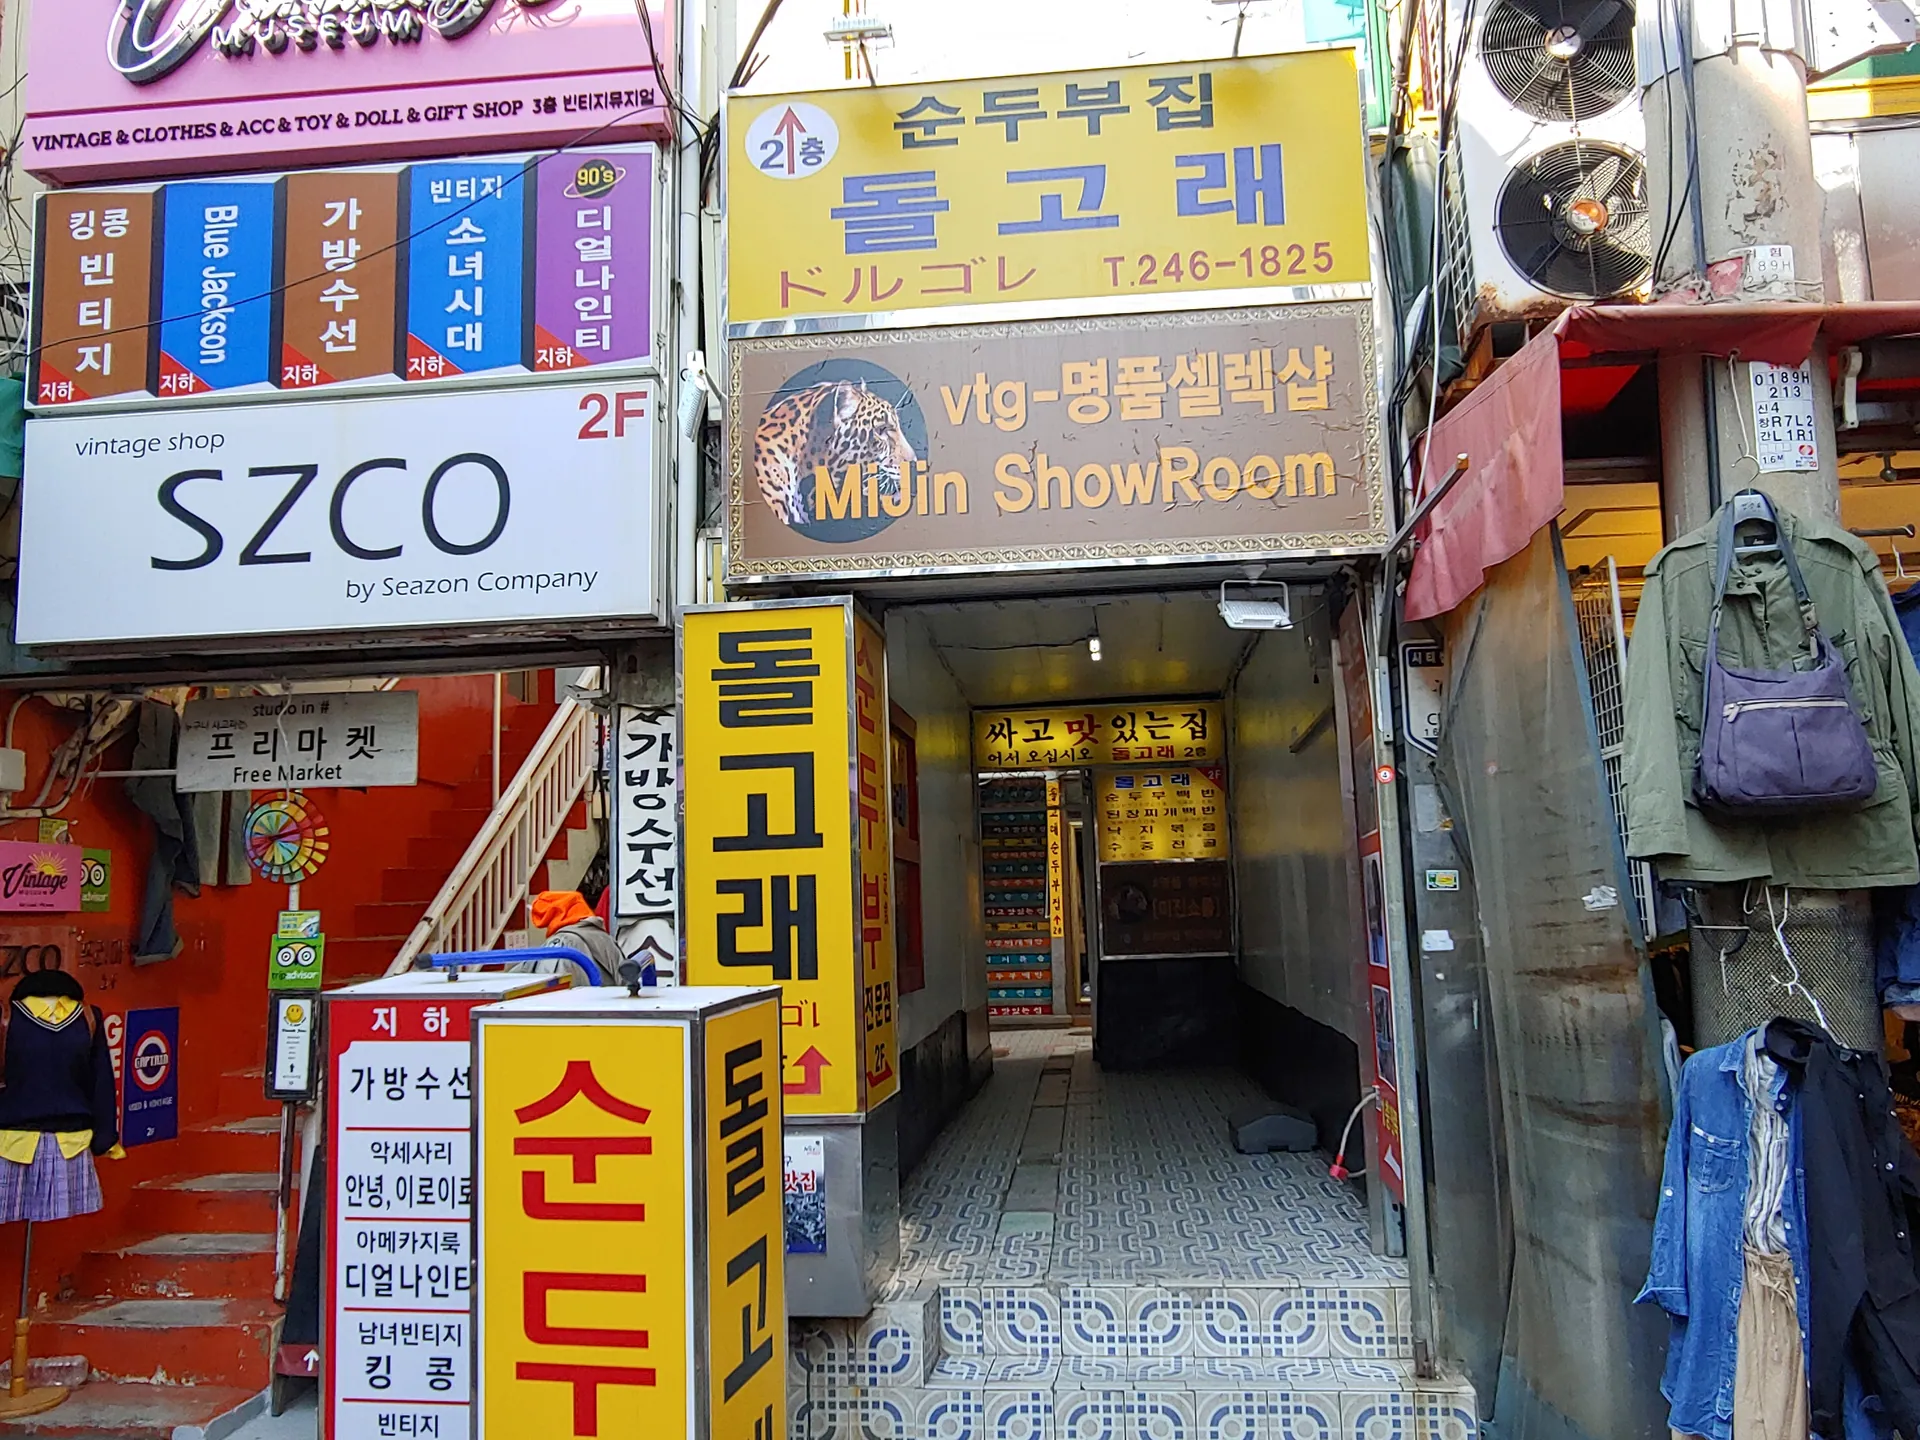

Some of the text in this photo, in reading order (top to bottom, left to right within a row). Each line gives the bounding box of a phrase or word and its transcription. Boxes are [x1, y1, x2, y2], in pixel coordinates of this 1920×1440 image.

[209, 8, 421, 58] MUSEUM
[32, 131, 112, 151] VINTAGE
[115, 129, 129, 145] &
[132, 123, 217, 143] CLOTHES
[220, 121, 234, 137] &
[236, 118, 275, 136] ACC
[278, 117, 292, 132] &
[294, 113, 333, 131] TOY
[336, 112, 350, 129] &
[354, 107, 403, 126] DOLL
[406, 107, 421, 123] &
[424, 103, 468, 122] GIFT
[472, 99, 523, 118] SHOP
[532, 96, 557, 114] 3층
[893, 72, 1215, 150] 순두부집
[430, 174, 503, 203] 빈티지
[575, 165, 616, 188] 90's
[830, 143, 1286, 255] 돌고래
[69, 207, 131, 241] 킹콩
[201, 204, 239, 260] Blue
[317, 197, 363, 354] 가방수선
[573, 205, 615, 352] 디얼나인티
[779, 254, 1037, 310] ドルゴレ
[1103, 241, 1334, 289] T.246-1825
[444, 216, 487, 354] 소녀시대
[75, 252, 114, 377] 빈티지
[198, 270, 238, 366] Jackson
[408, 354, 446, 378] 지하
[536, 345, 574, 368] 지하
[40, 380, 75, 403] 지하
[159, 371, 196, 395] 지하
[282, 363, 319, 388] 지하
[939, 345, 1334, 433] vtg-명품셀렉샵
[1754, 371, 1810, 386] 0189H
[1769, 386, 1801, 399] 213
[577, 390, 648, 440] 2F
[75, 430, 226, 458] vintage shop
[814, 445, 1337, 523] MiJin ShowRoom
[150, 452, 512, 571] SZCO
[345, 568, 599, 602] by Seazon Company
[252, 700, 297, 717] studio
[301, 702, 315, 715] in
[206, 725, 384, 763] 프리마켓
[984, 717, 1056, 750] 싸고
[987, 750, 1020, 766] 어서
[1026, 747, 1094, 764] 오십시오
[1111, 745, 1175, 762] 돌고래
[232, 763, 343, 784] Free Market
[1207, 769, 1221, 780] 2F
[622, 732, 676, 907] 가방수선
[709, 627, 825, 982] 돌고래
[857, 637, 881, 970] 순두부
[3, 862, 68, 899] Vintage
[371, 1006, 451, 1038] 지하
[874, 1043, 886, 1073] 2F
[350, 1066, 471, 1101] 가방수선
[370, 1141, 452, 1166] 악세사리
[357, 1230, 461, 1255] 아메카지룩
[358, 1321, 462, 1348] 남녀빈티지
[365, 1354, 456, 1392] 킹콩
[378, 1412, 440, 1439] 빈티지
